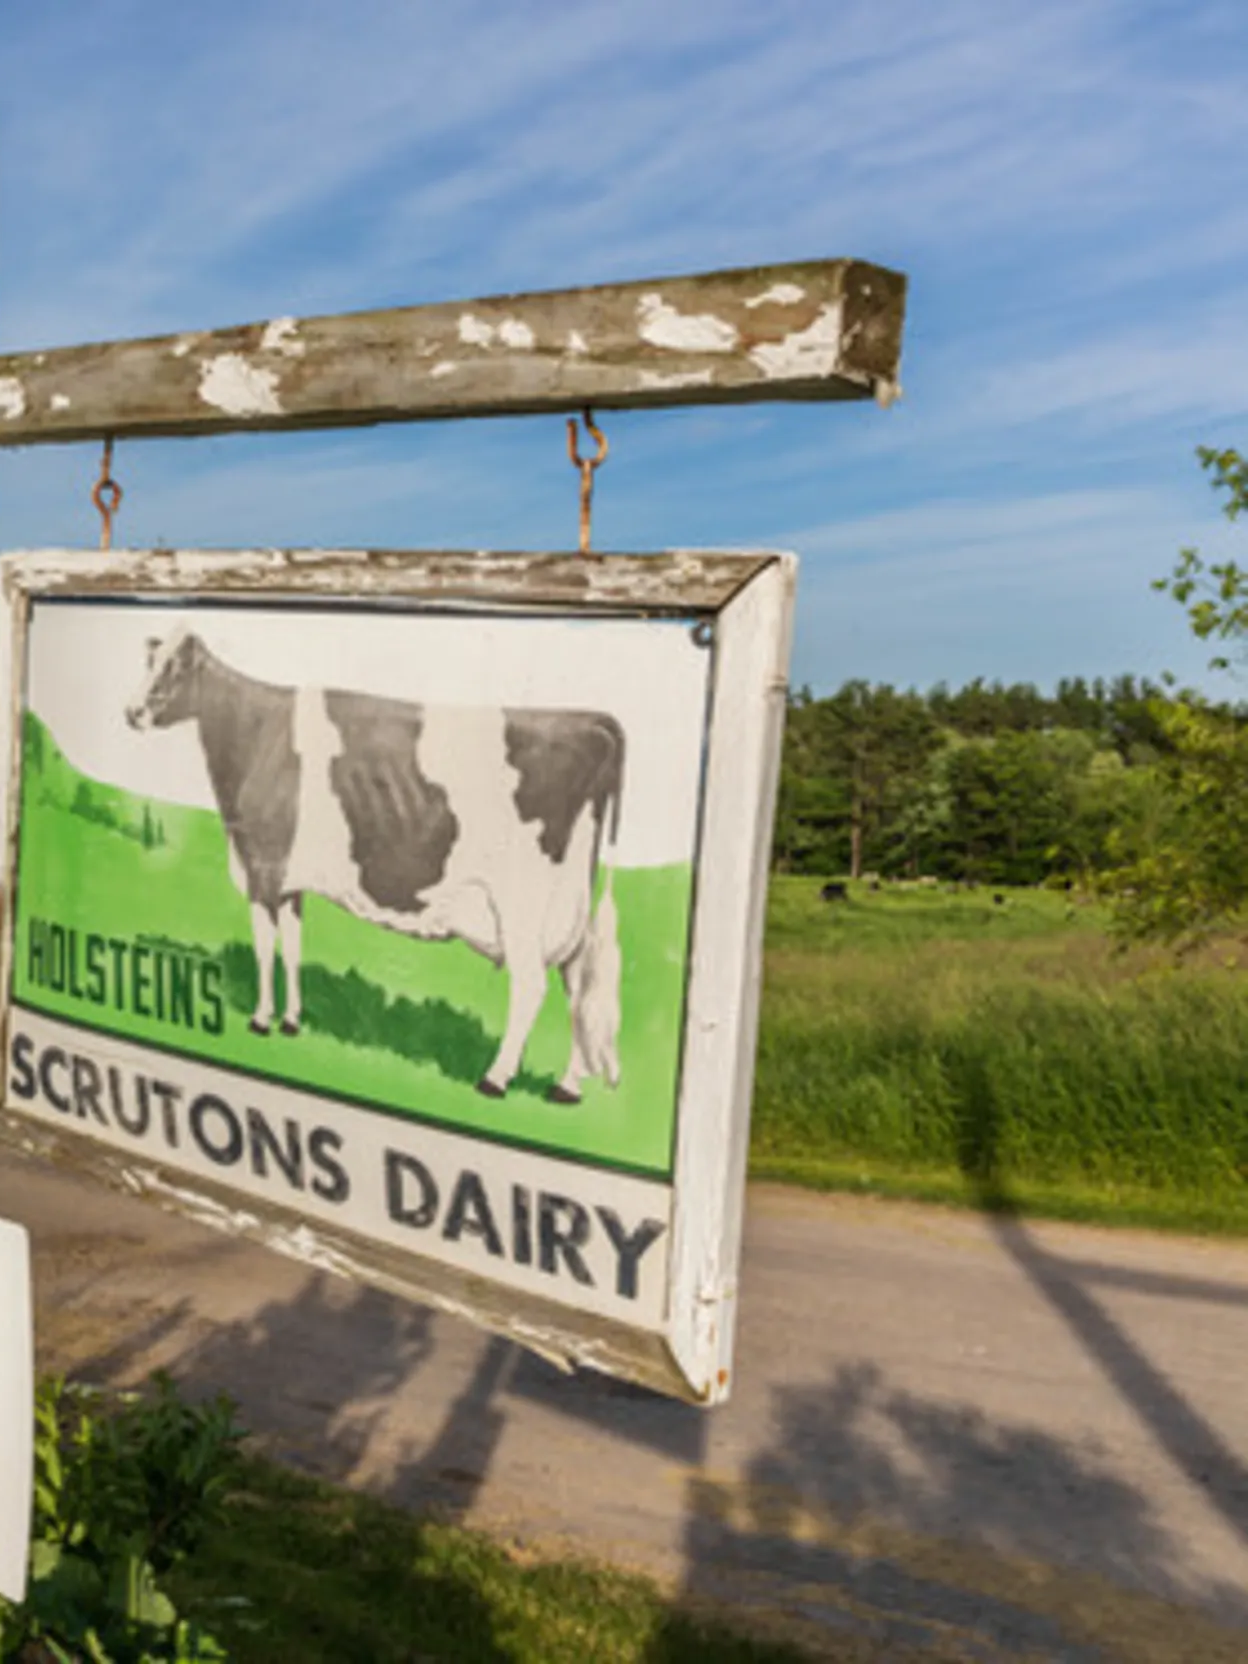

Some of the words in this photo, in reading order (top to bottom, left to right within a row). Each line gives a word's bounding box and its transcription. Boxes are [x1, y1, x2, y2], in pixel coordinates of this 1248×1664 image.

[28, 919, 223, 1033] HOLSTEINS
[10, 1034, 349, 1202] SCRUTONS
[384, 1147, 666, 1300] DAIRY
